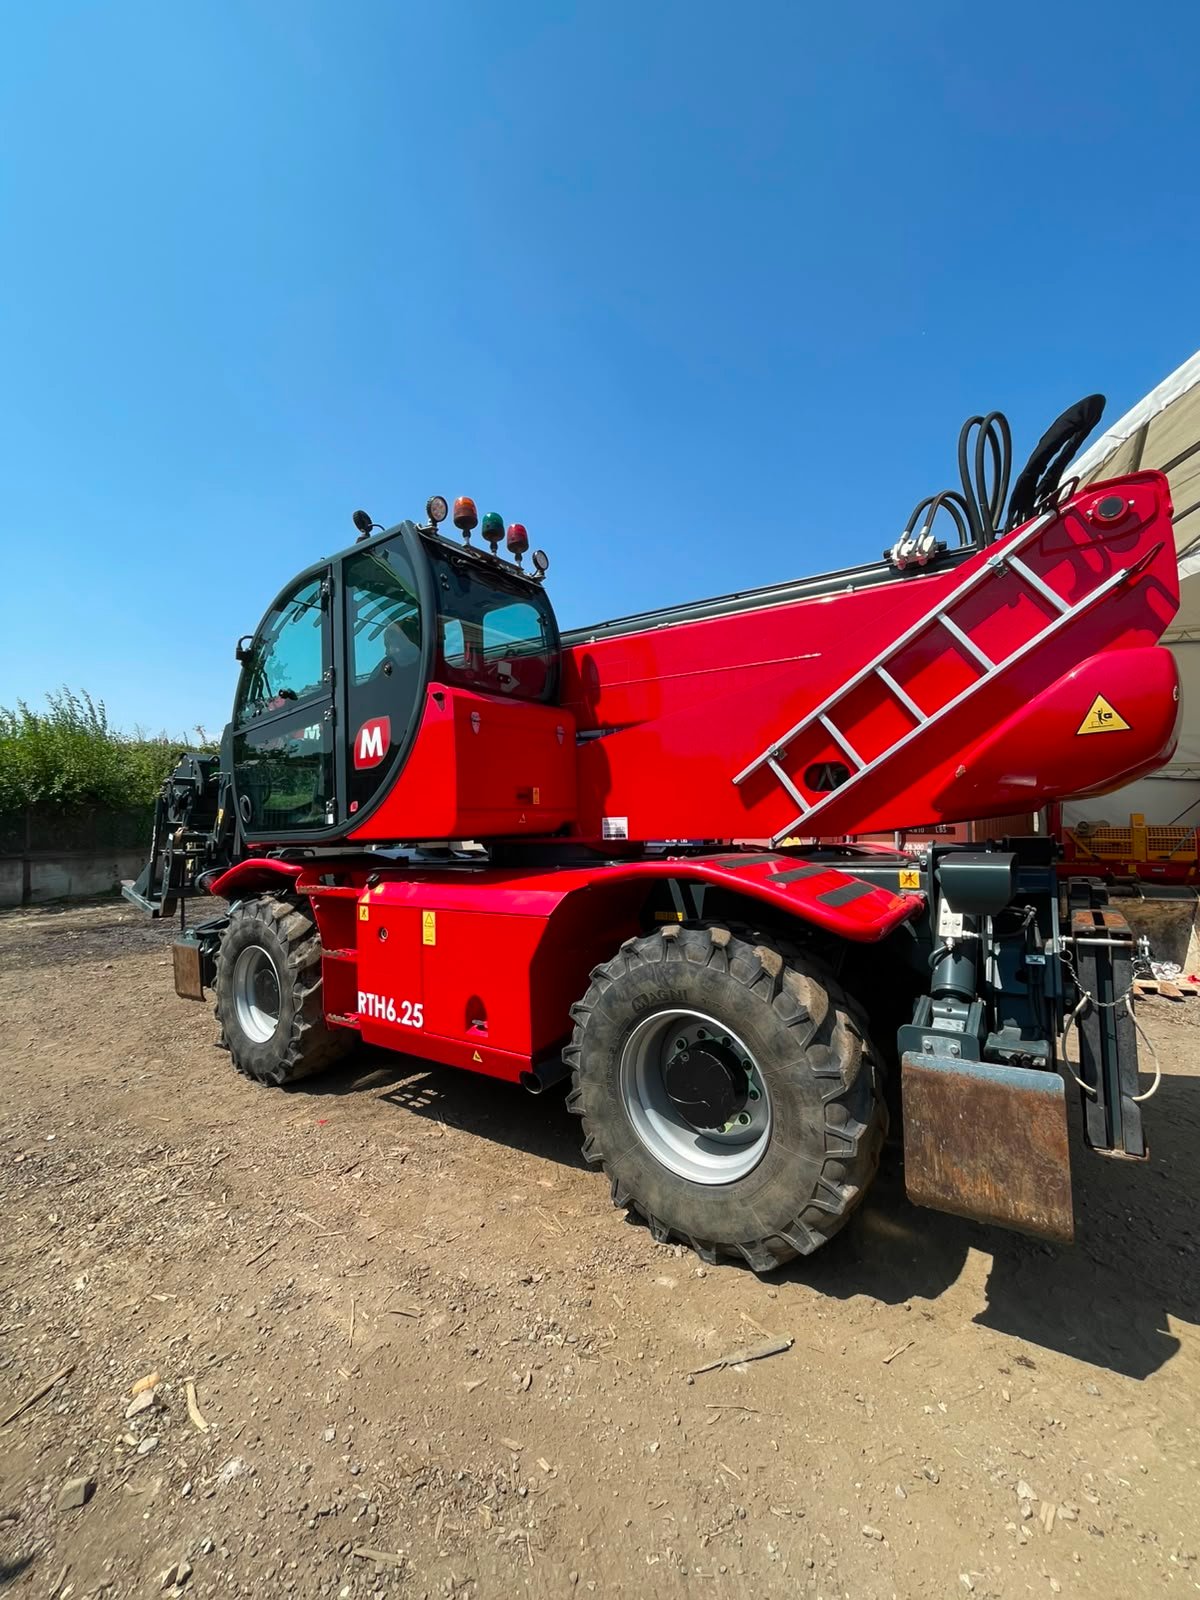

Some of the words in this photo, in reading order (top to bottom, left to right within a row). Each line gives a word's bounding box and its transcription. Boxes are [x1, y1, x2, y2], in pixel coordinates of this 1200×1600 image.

[360, 727, 384, 760] M
[358, 991, 424, 1028] RTH6.25
[632, 989, 688, 1014] MAGNI
